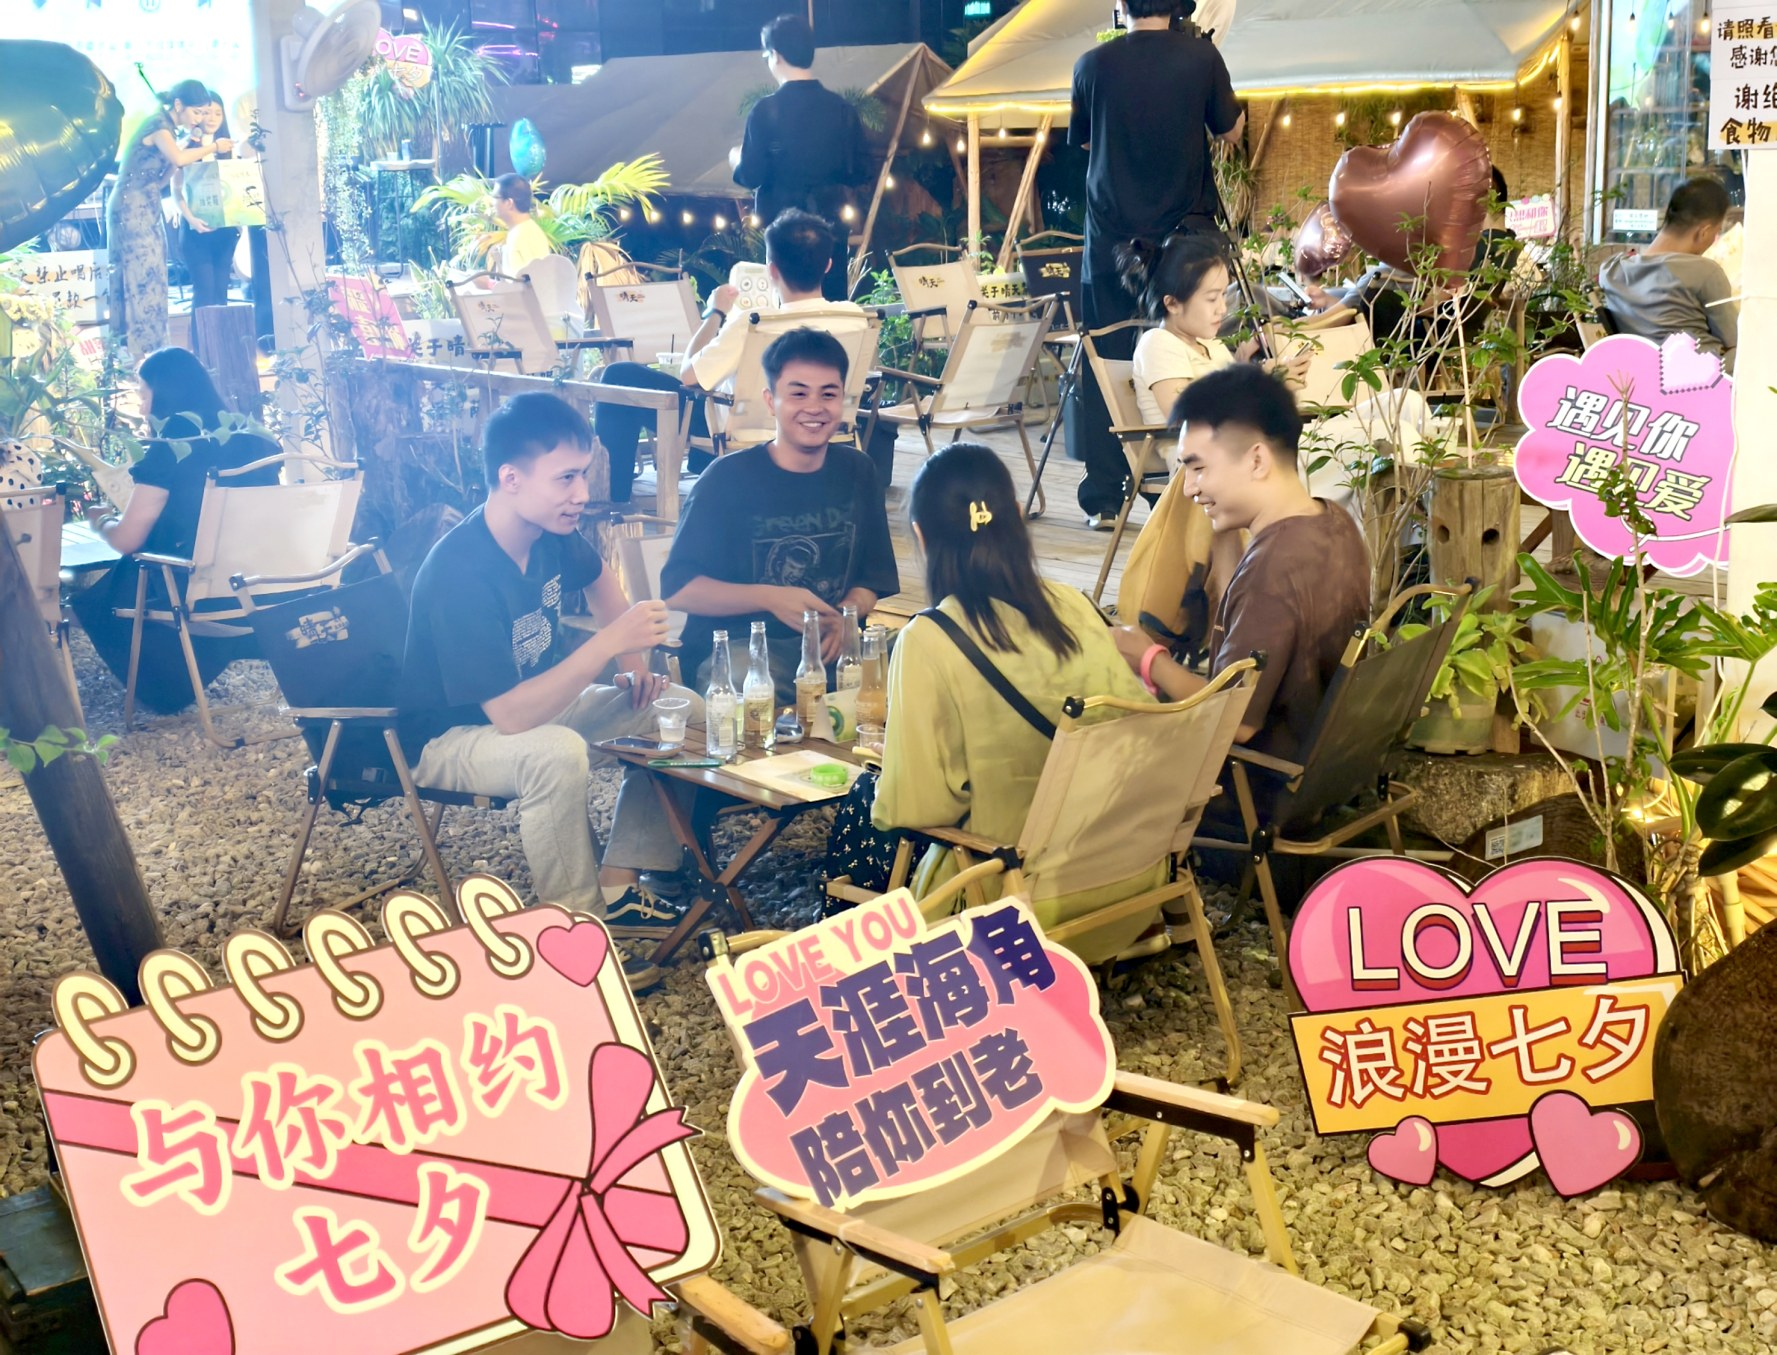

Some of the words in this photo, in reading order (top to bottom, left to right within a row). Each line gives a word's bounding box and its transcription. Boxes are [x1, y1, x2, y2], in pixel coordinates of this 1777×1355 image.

[376, 39, 421, 62] OVE
[1718, 16, 1777, 41] 请照看
[1720, 117, 1777, 147] 食物
[980, 283, 1028, 298] 关于晴天
[1546, 385, 1700, 462] 遇见你
[717, 934, 834, 1016] LOVE
[830, 897, 918, 963] YOU
[1347, 900, 1608, 990] LOVE
[743, 905, 1056, 1117] 天涯海角
[1319, 994, 1650, 1109] 浪漫七夕
[122, 1006, 566, 1213] 与你相约
[790, 1027, 1043, 1209] 陪你到老
[276, 1163, 490, 1314] 七夕
